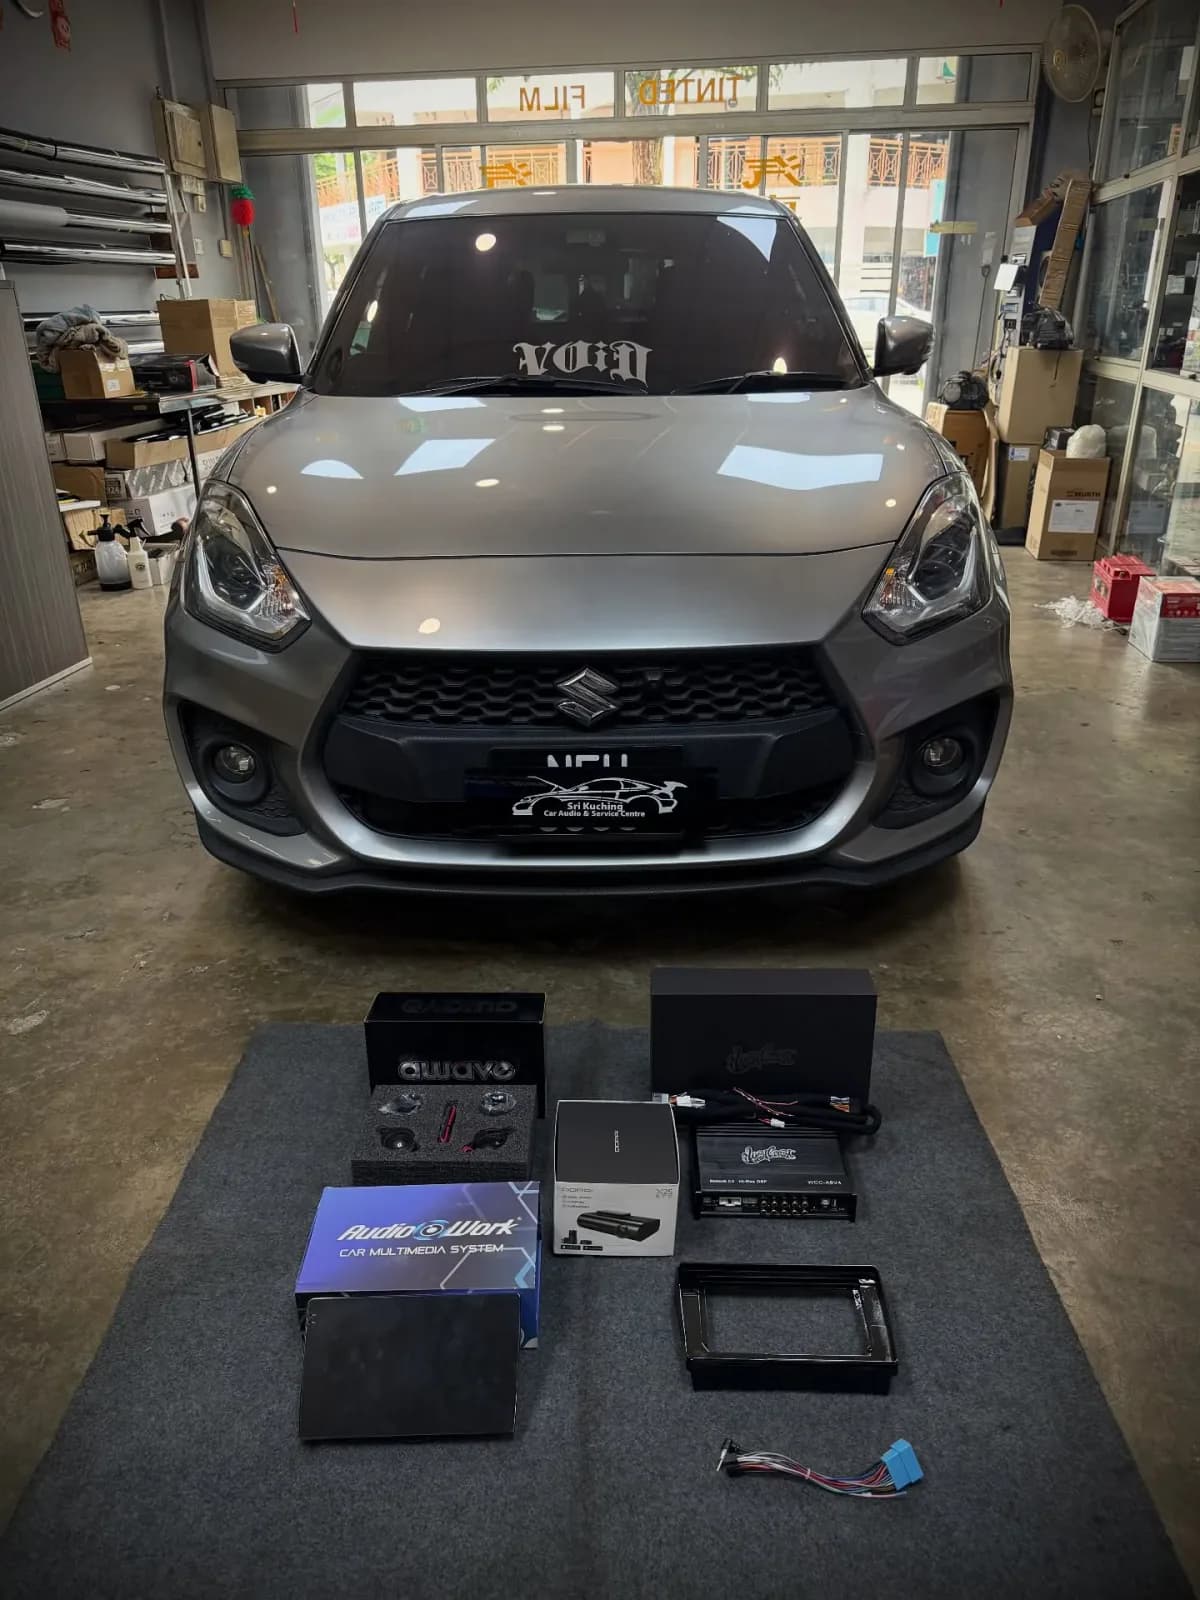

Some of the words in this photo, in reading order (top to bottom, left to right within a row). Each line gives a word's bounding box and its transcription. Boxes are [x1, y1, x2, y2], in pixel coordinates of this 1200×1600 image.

[398, 1060, 515, 1081] awave
[337, 1222, 417, 1241] Audio
[446, 1218, 519, 1237] Work
[339, 1248, 366, 1258] CAR
[369, 1245, 446, 1257] MULTIMEDIA
[450, 1243, 504, 1254] SYSTEM
